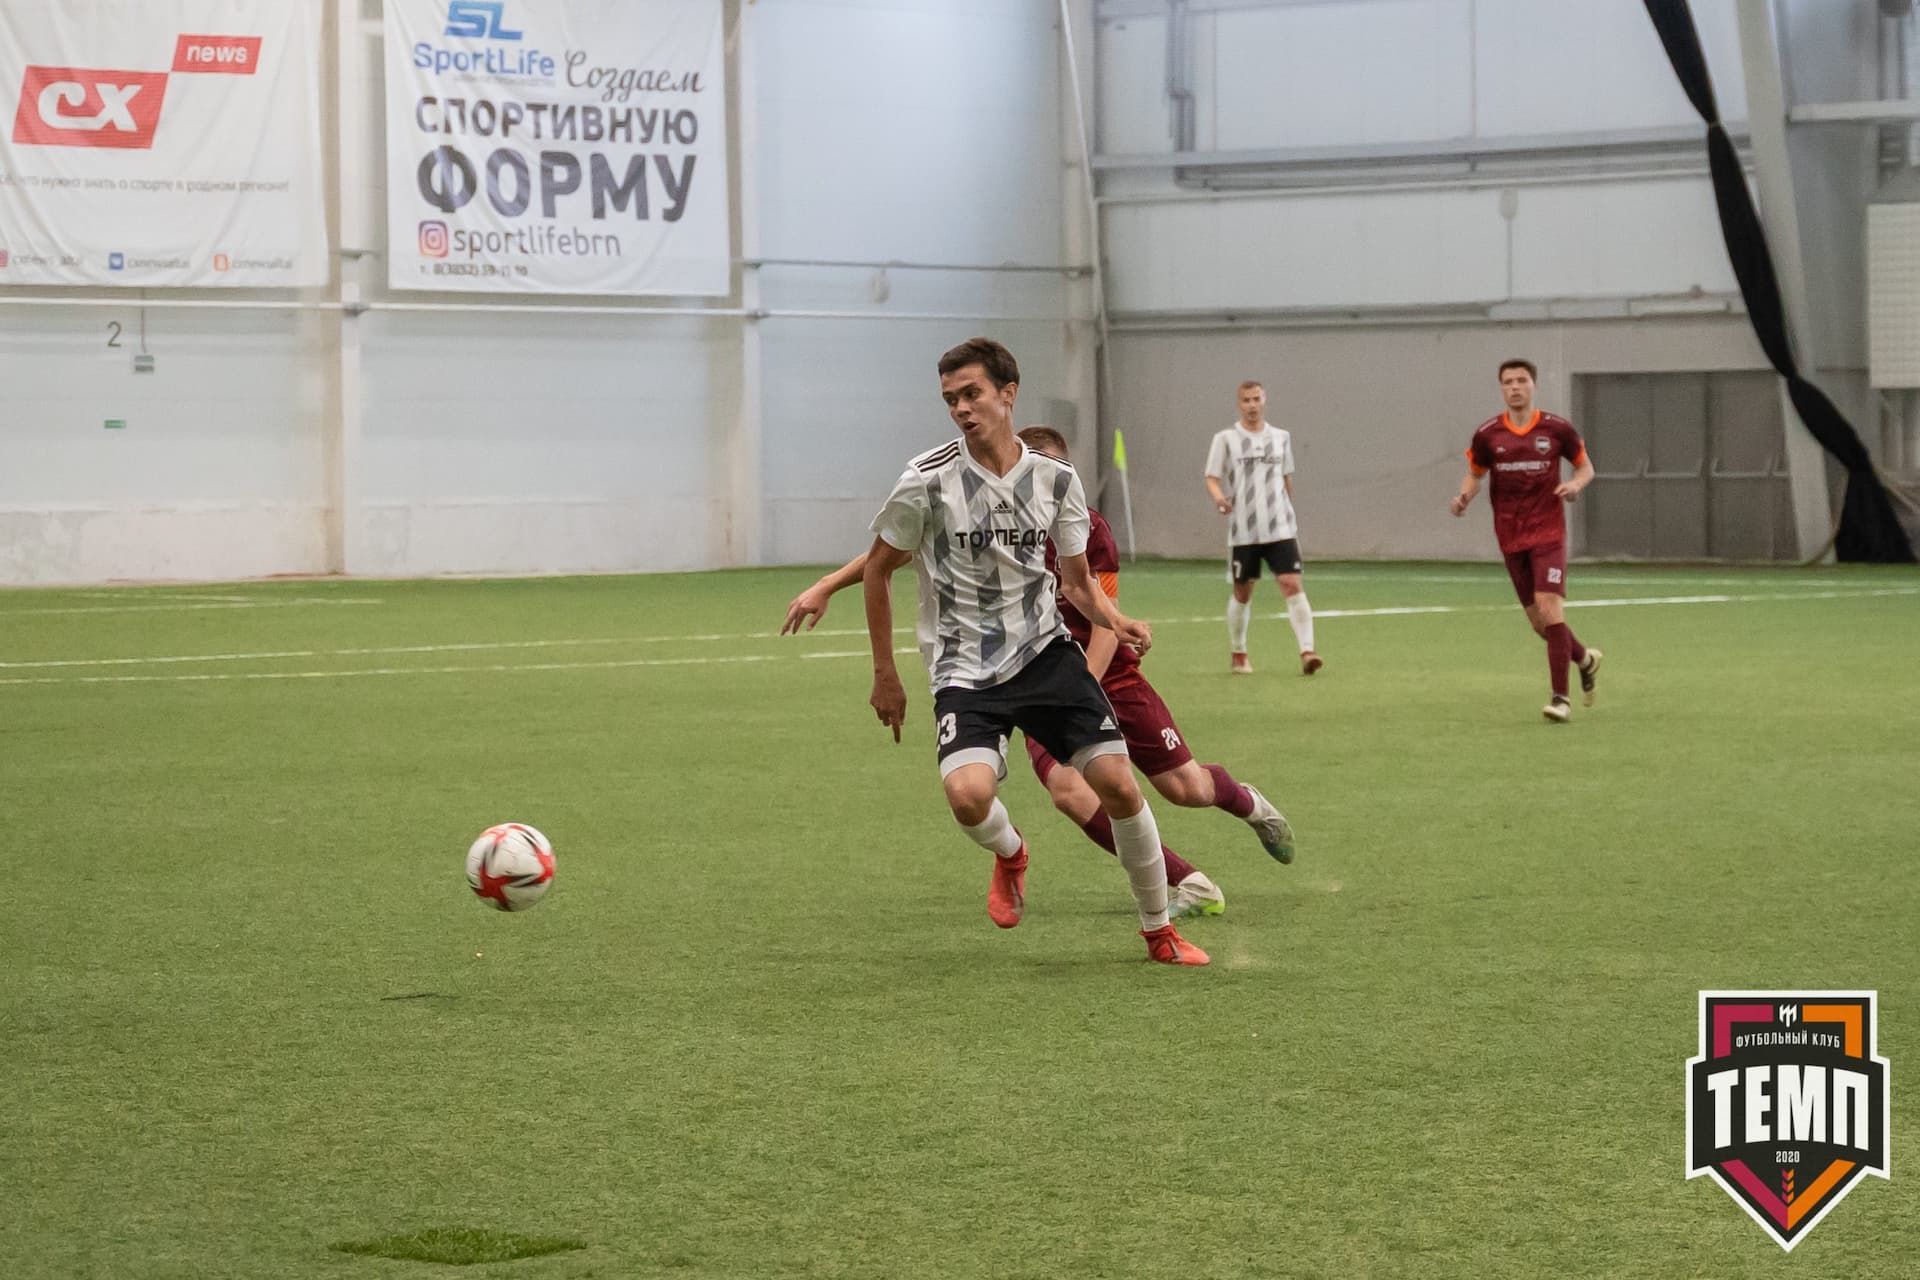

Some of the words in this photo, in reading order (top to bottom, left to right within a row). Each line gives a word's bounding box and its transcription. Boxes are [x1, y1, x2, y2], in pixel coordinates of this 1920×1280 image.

[187, 45, 248, 63] news
[413, 42, 555, 76] SportLife
[564, 50, 704, 102] Создаем
[416, 96, 698, 145] СПОРТИВНУЮ
[417, 145, 697, 223] ФОРМУ
[453, 227, 622, 260] sportlifebrn
[107, 321, 122, 347] 2
[954, 528, 1047, 550] ТОРПЕДО
[937, 712, 957, 746] 3
[1161, 727, 1181, 751] 24
